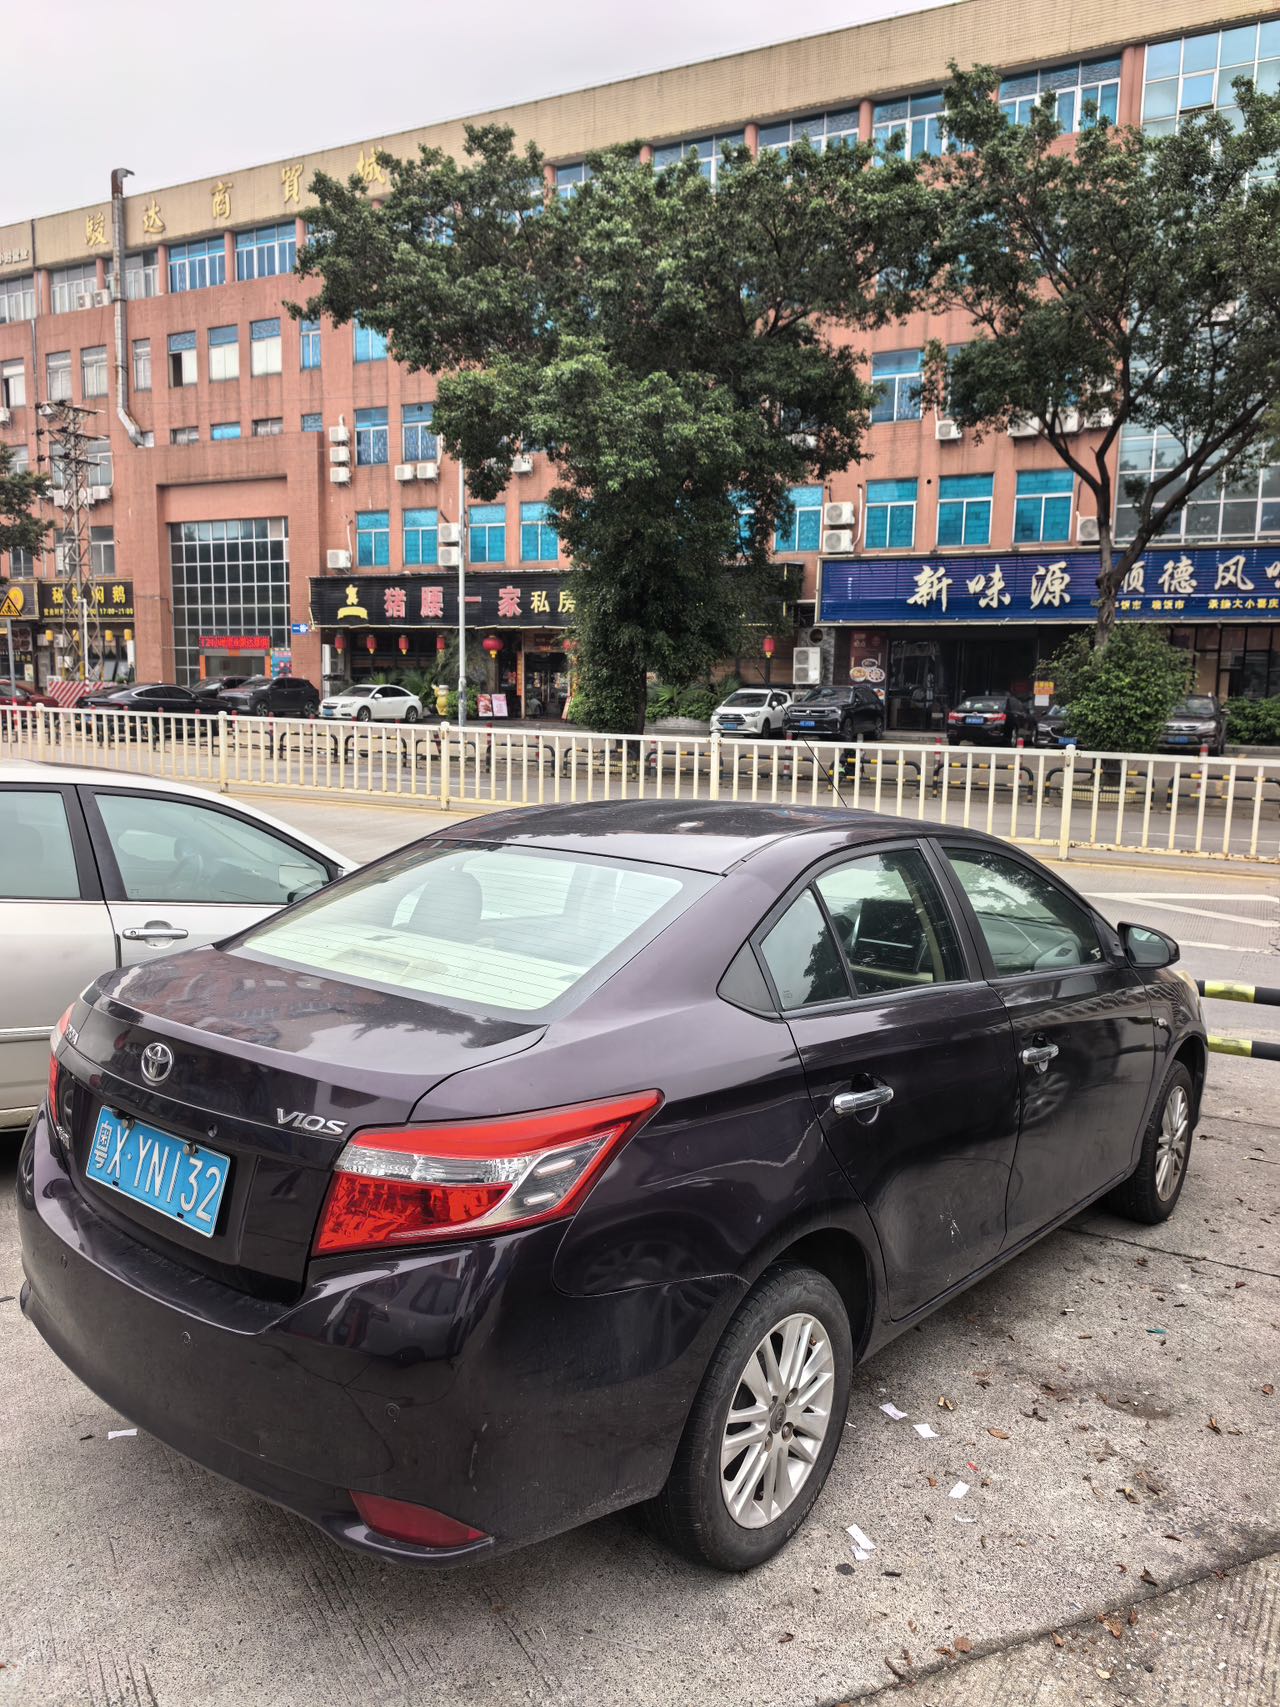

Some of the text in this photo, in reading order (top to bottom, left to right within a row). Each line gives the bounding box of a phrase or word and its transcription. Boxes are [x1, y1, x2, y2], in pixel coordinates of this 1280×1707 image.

[906, 561, 1071, 612] 新味源
[276, 1107, 348, 1136] VIOS
